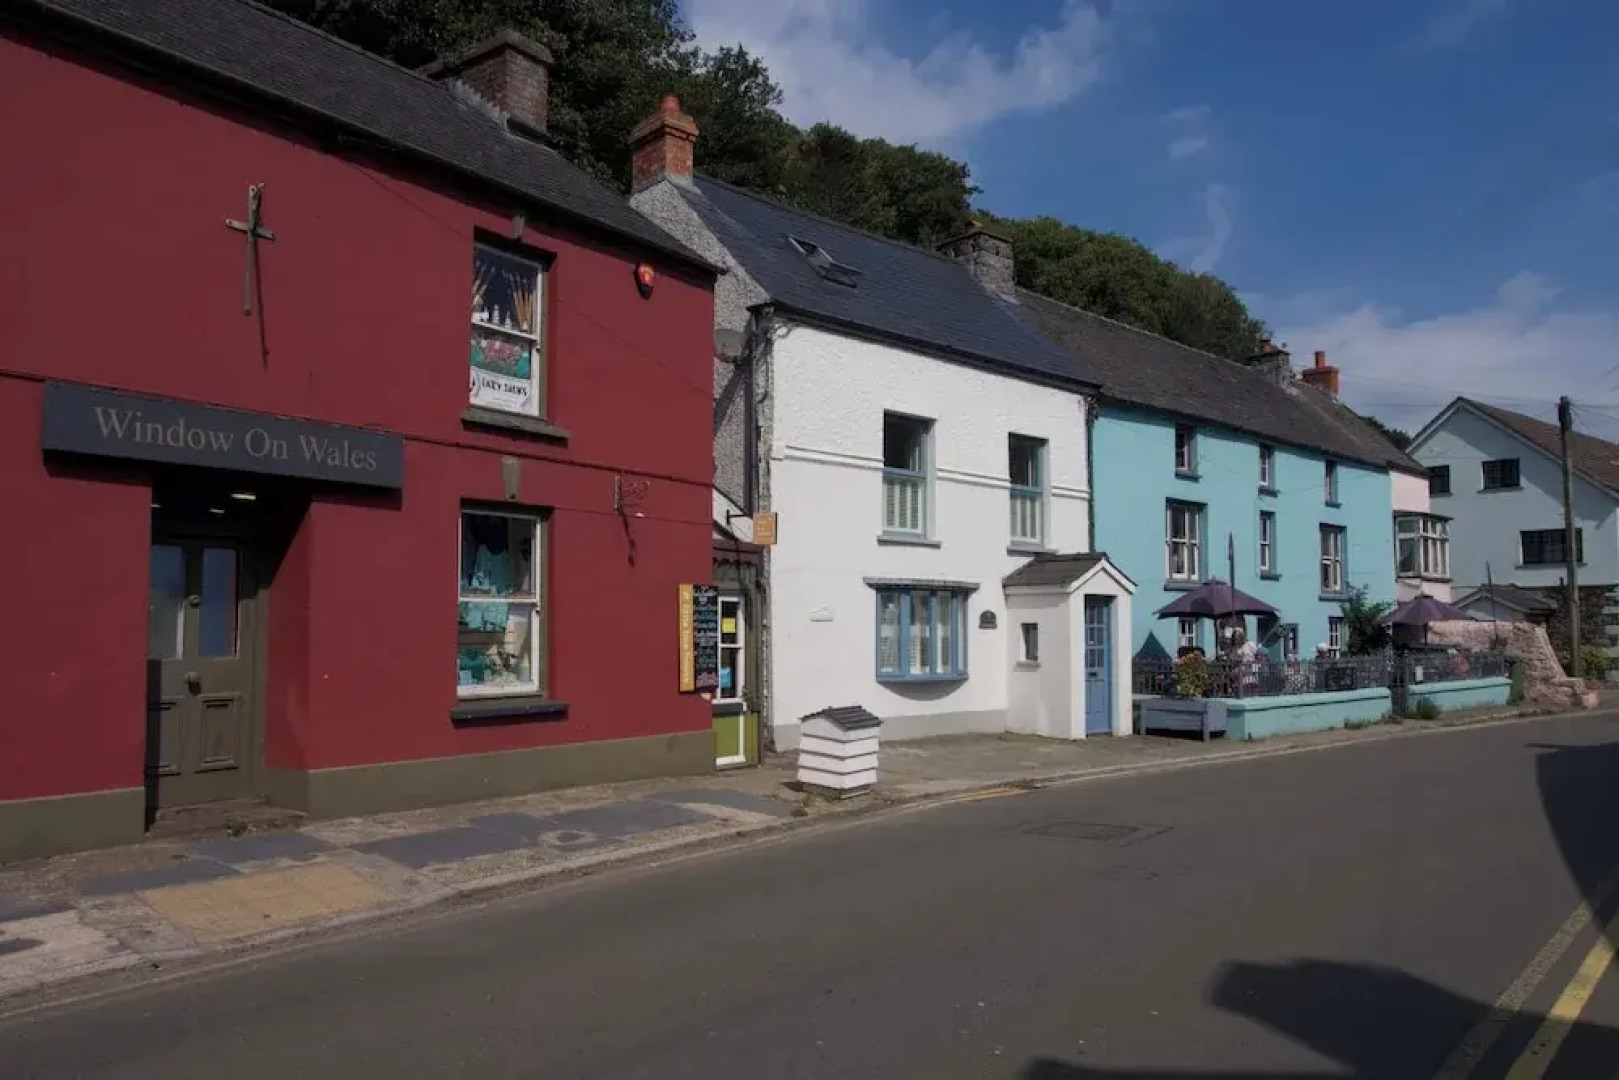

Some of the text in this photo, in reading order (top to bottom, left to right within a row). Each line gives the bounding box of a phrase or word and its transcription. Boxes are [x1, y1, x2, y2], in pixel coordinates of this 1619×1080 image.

[92, 405, 378, 472] Window On Wales
